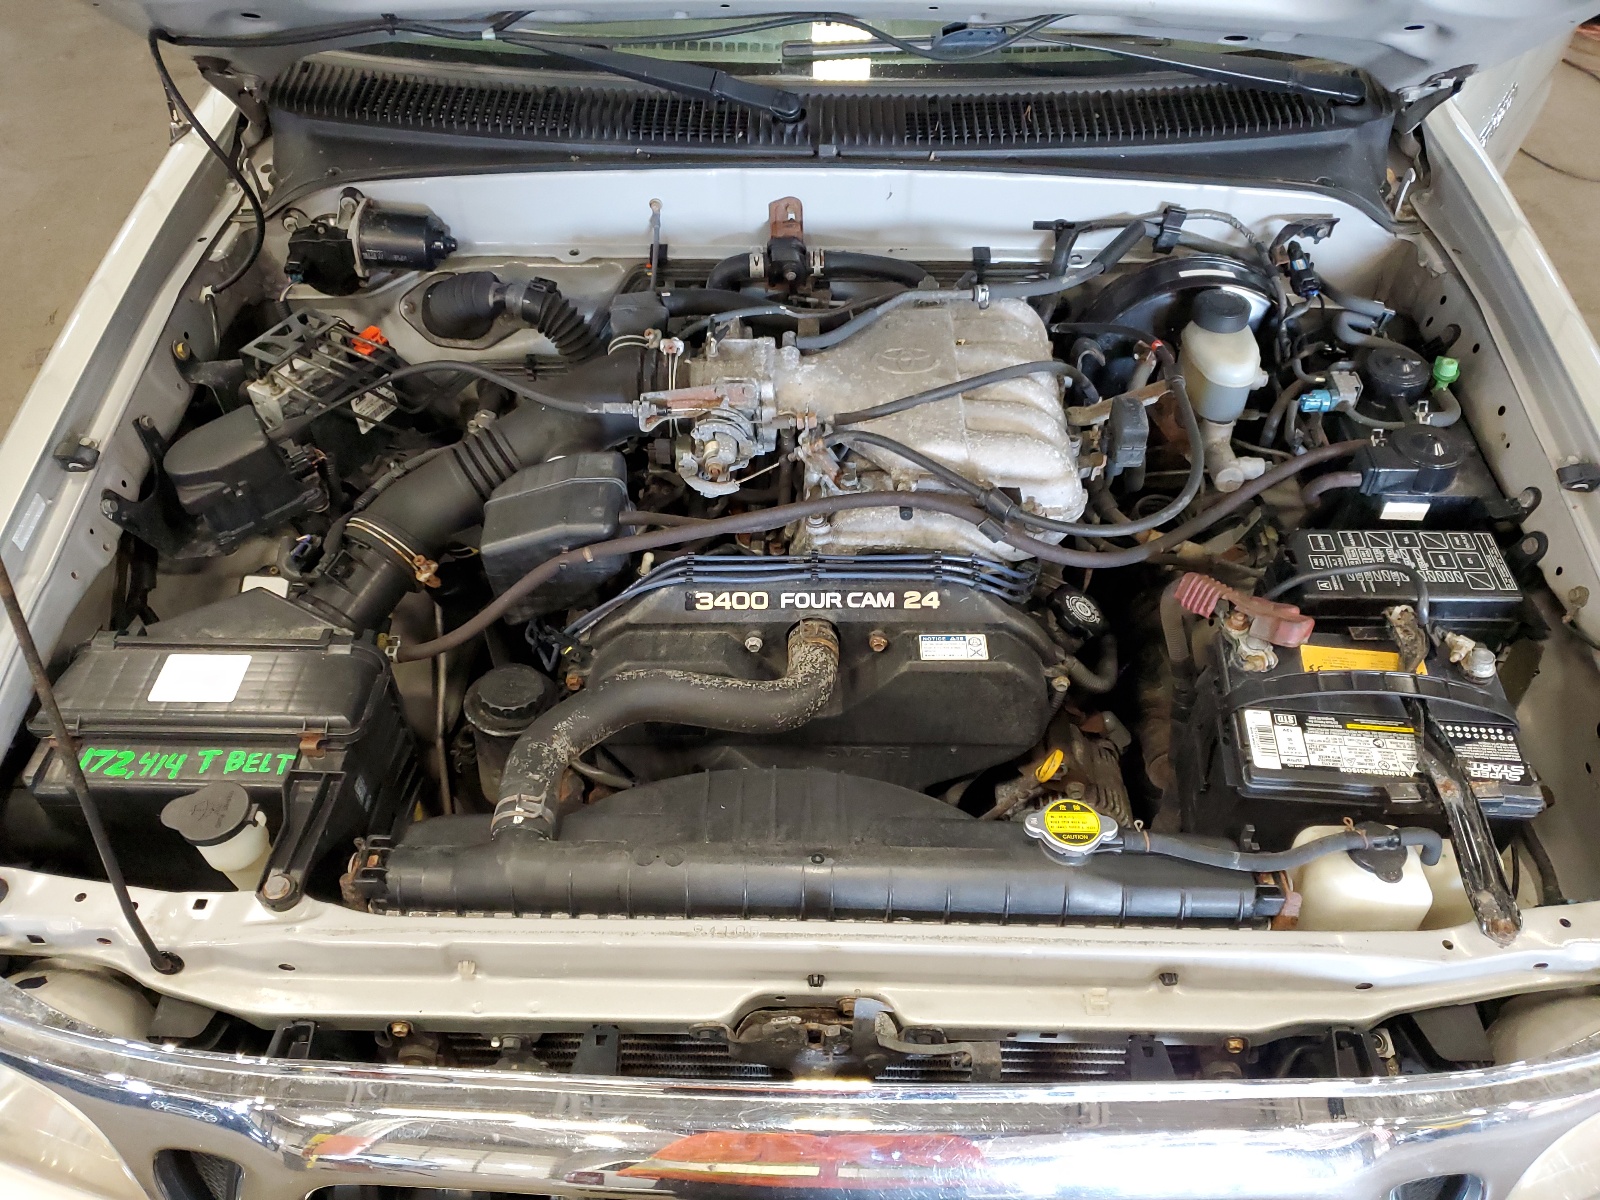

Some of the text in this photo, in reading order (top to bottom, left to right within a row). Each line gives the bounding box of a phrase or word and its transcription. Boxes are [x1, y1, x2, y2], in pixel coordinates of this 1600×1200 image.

[695, 591, 941, 610] 3400 FOUR CAM 24
[79, 747, 297, 780] 172,414 T BELT
[1469, 761, 1525, 776] START
[1471, 769, 1521, 782] SUPER
